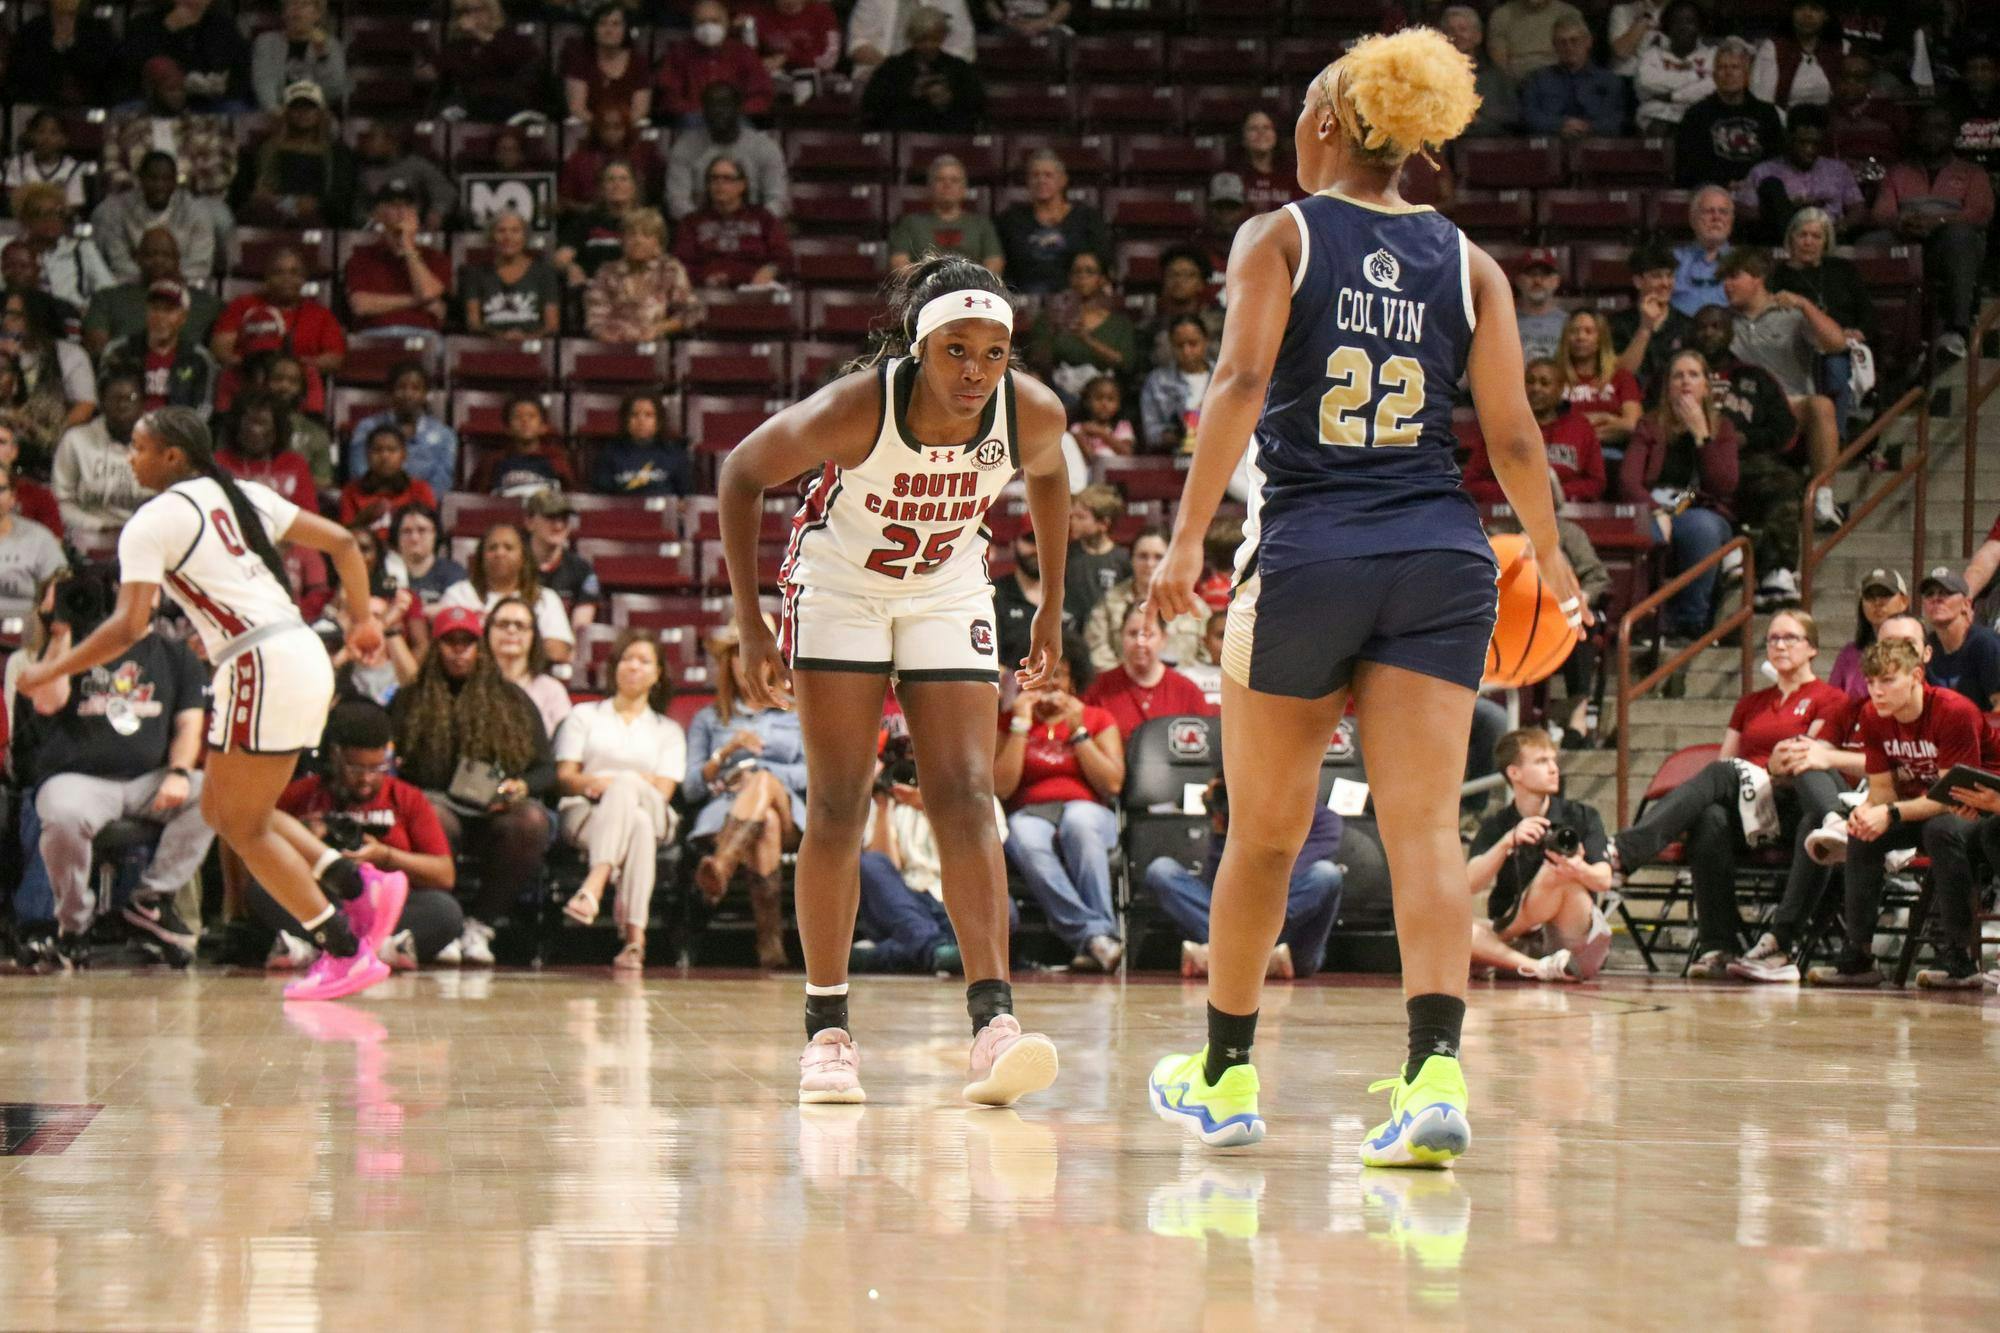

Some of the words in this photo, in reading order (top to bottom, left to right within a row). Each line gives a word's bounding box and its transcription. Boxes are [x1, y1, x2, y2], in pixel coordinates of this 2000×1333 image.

[1337, 287, 1425, 343] COLVIN
[1319, 346, 1425, 448] 22
[979, 441, 1003, 464] SEC
[864, 493, 991, 522] CAROLINA
[892, 472, 978, 497] SOUTH
[210, 508, 245, 556] 0
[864, 523, 965, 580] 25
